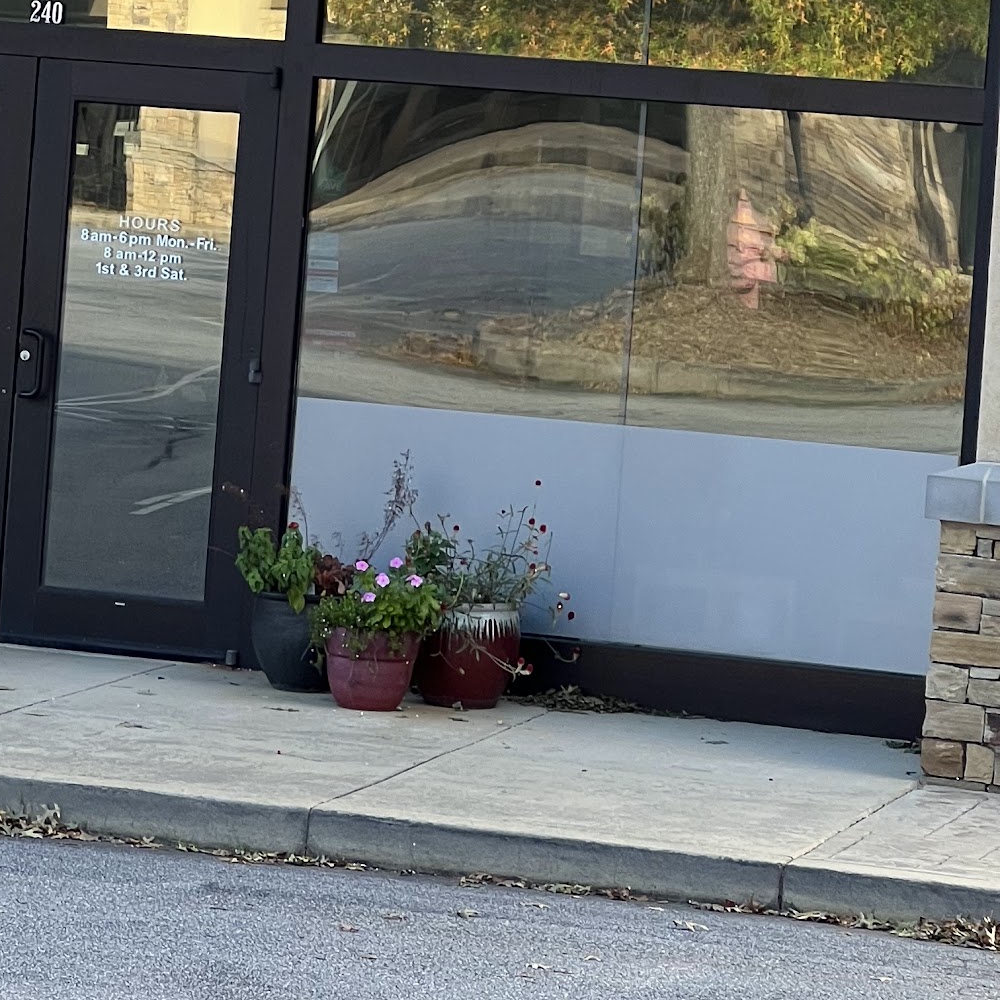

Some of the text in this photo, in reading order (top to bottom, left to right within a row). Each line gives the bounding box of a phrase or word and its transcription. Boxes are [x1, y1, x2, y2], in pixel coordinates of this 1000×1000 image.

[30, 0, 63, 25] 240
[119, 216, 181, 232] HOURS
[103, 247, 111, 258] 8
[160, 254, 181, 265] pm
[96, 262, 187, 280] 1st & 3rd Sat.
